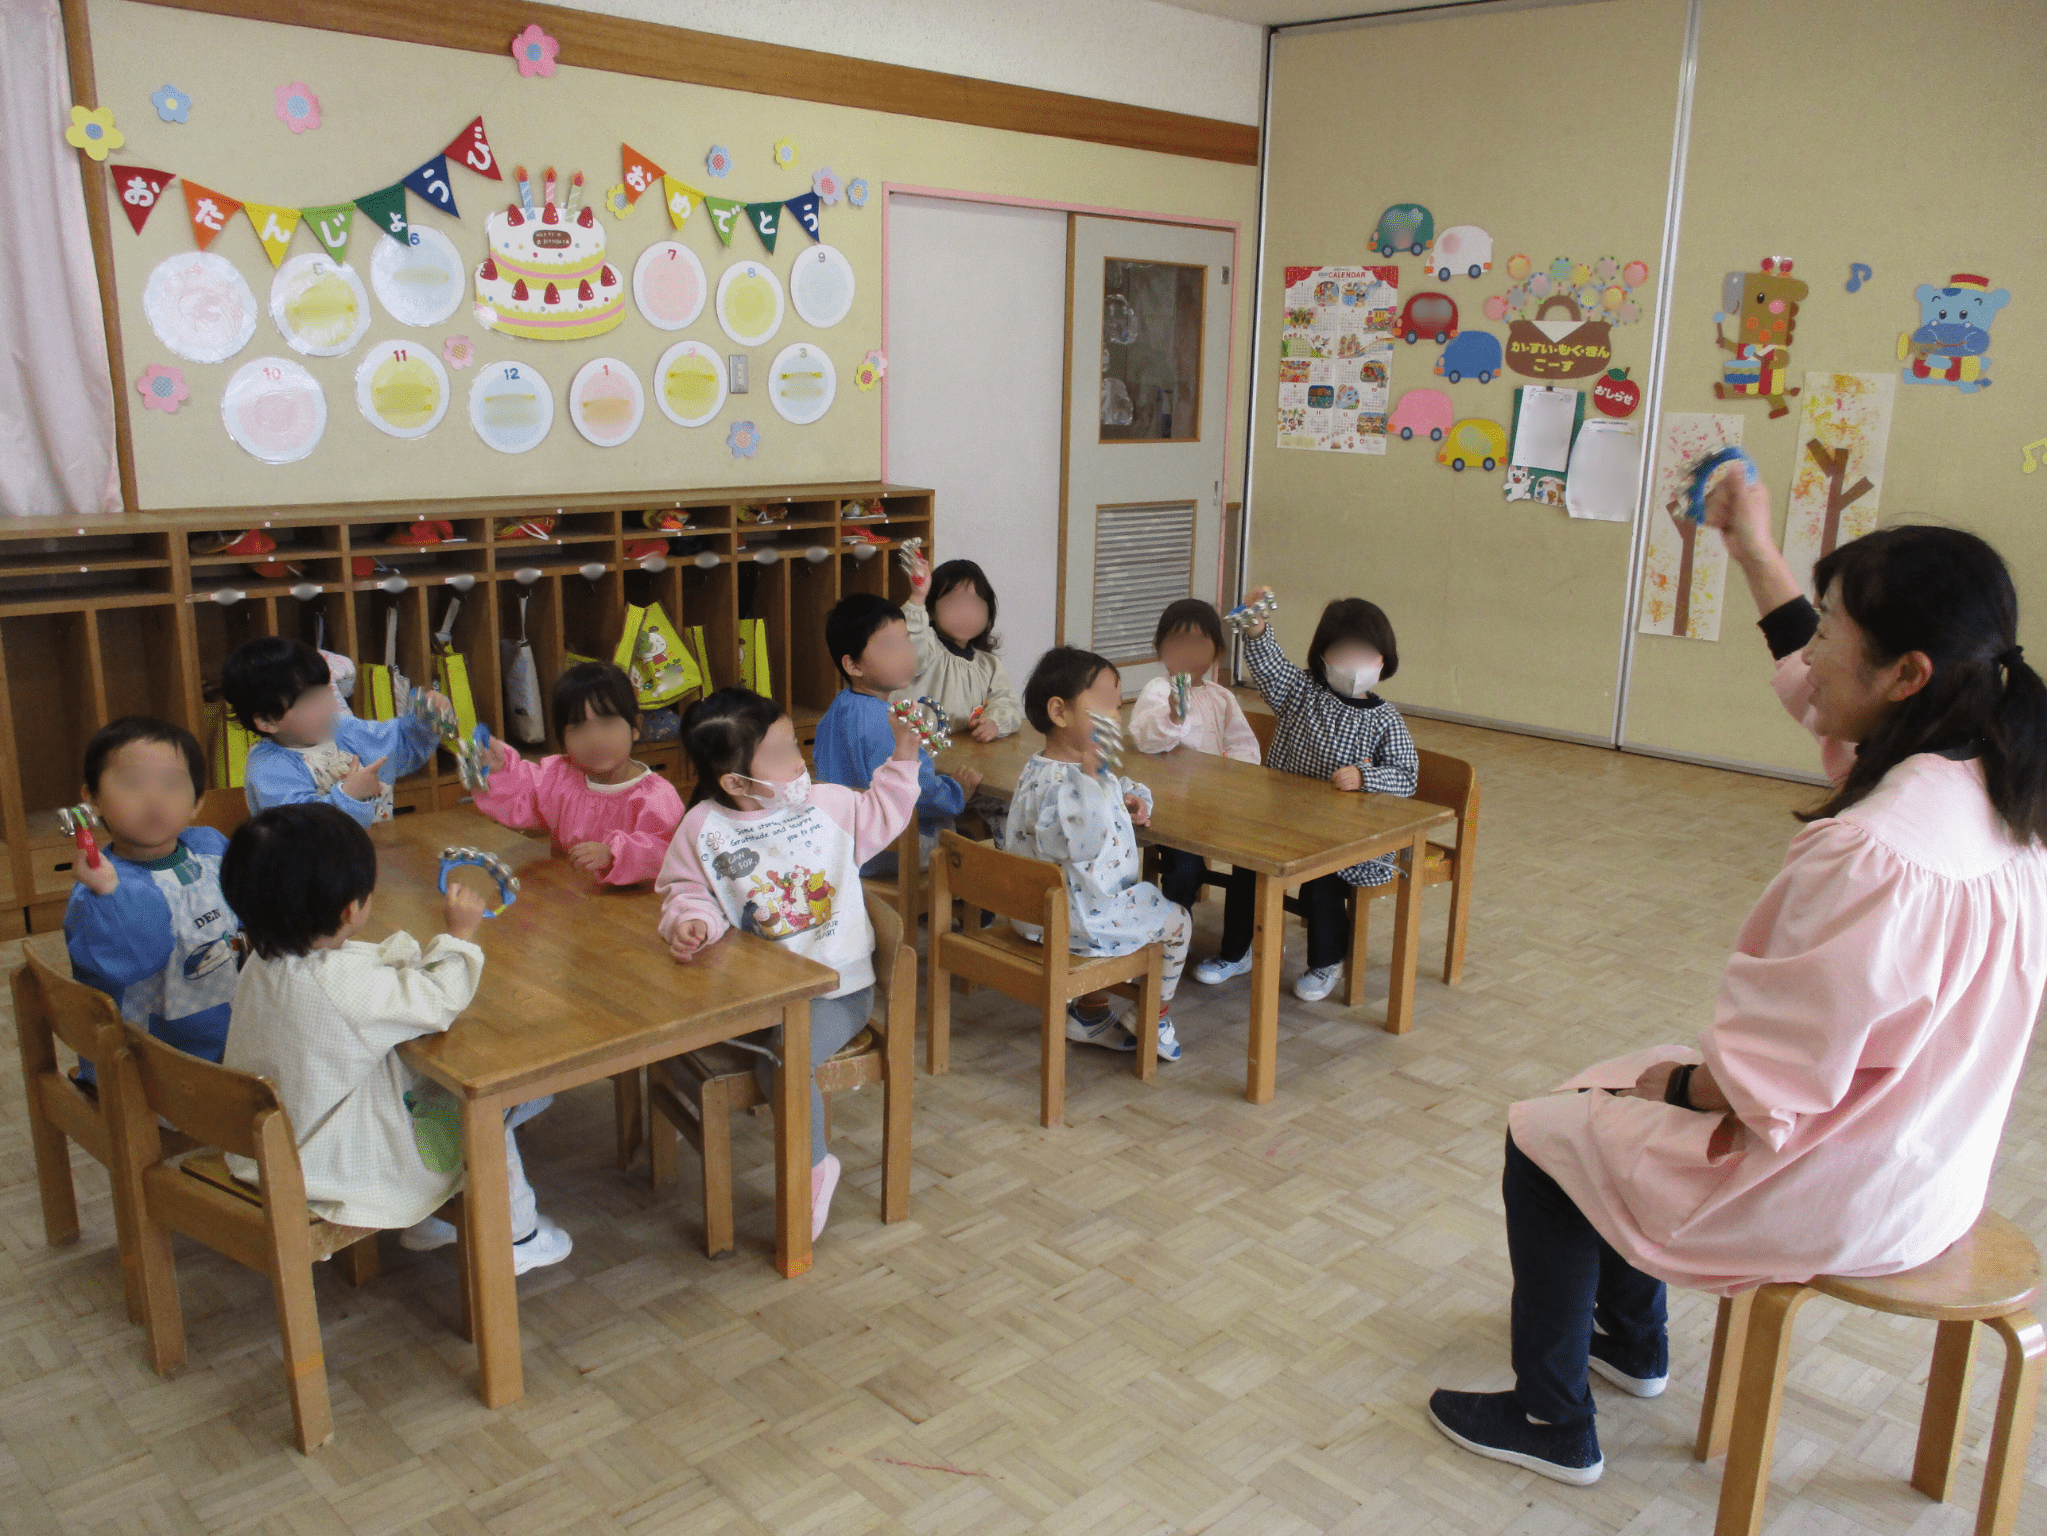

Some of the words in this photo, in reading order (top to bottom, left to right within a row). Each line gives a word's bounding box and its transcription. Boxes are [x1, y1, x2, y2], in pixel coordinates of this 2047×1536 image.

[626, 165, 819, 235] おめでとう
[409, 232, 420, 246] 6
[668, 249, 677, 260] 7
[818, 252, 826, 263] 9
[747, 267, 756, 278] 8
[393, 350, 407, 362] 11
[688, 347, 696, 358] 2
[800, 348, 808, 358] 3
[263, 367, 281, 380] 10
[504, 368, 520, 380] 12
[603, 364, 609, 375] 1
[1594, 385, 1634, 406] おしらせ
[730, 832, 769, 847] Gratitude
[772, 826, 787, 836] and
[735, 827, 755, 836] Some
[786, 834, 799, 843] you
[194, 908, 221, 929] DEN
